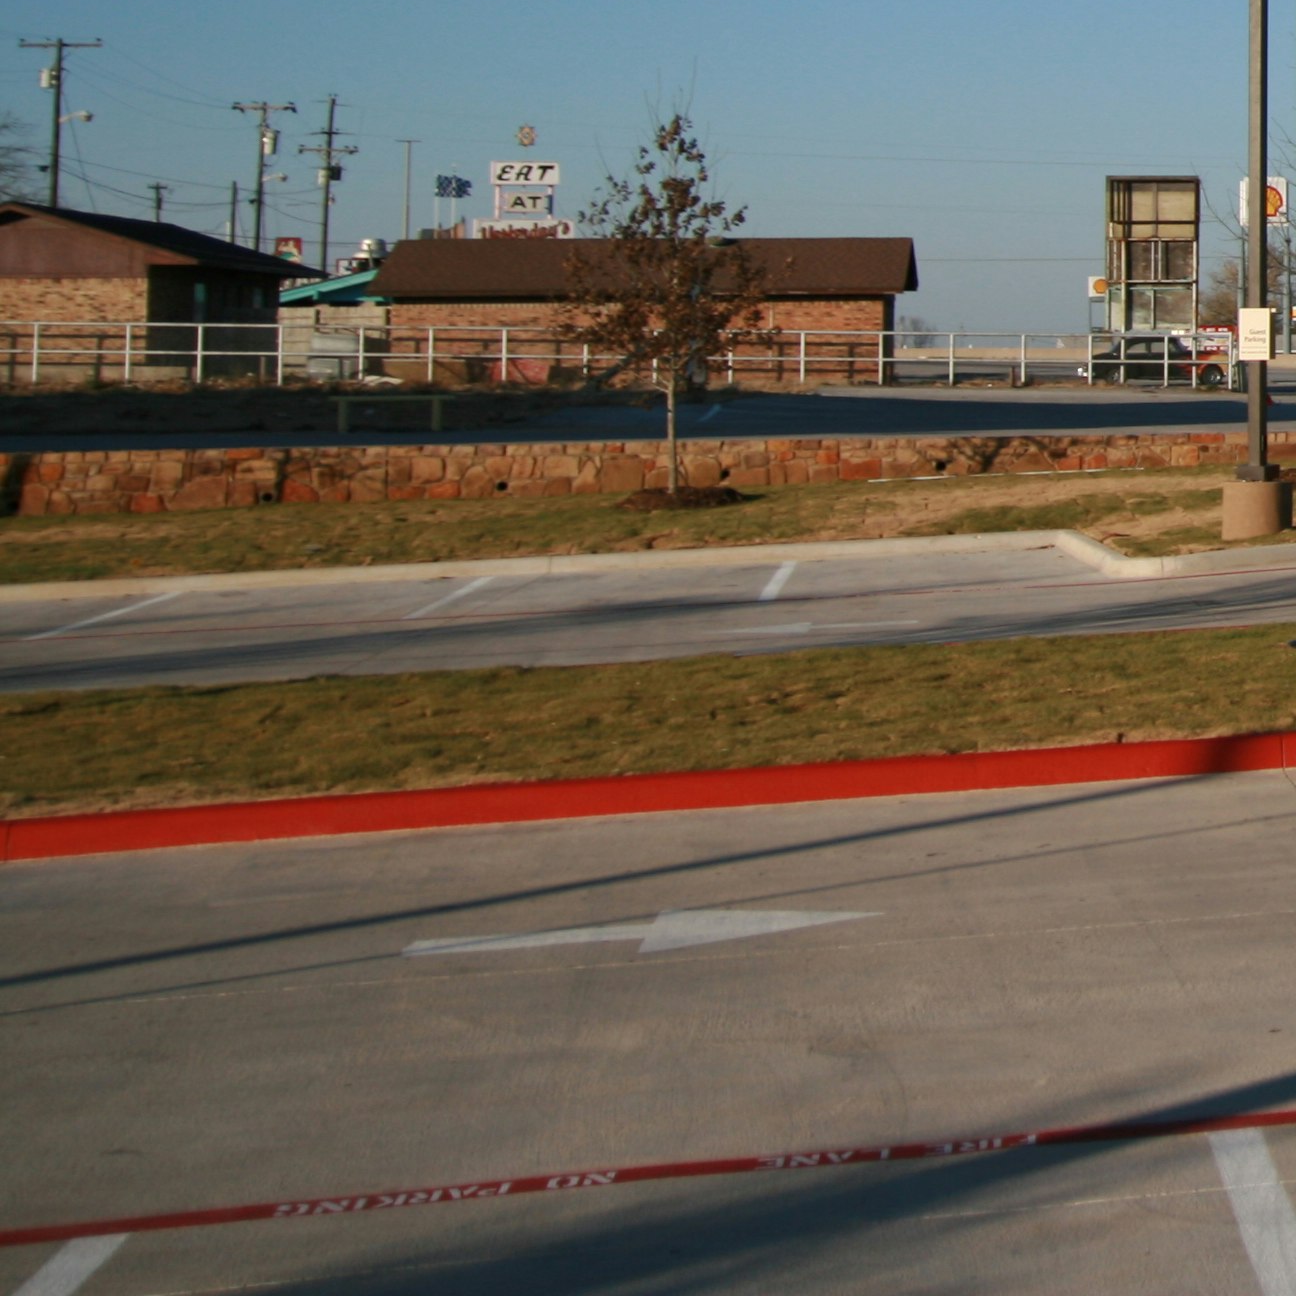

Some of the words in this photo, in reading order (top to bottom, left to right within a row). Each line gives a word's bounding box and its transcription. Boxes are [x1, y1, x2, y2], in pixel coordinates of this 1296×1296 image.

[496, 165, 555, 181] EAT
[510, 196, 542, 208] AT
[756, 1148, 890, 1171] LANE
[545, 1171, 617, 1190] NO
[273, 1182, 513, 1218] PARKING
